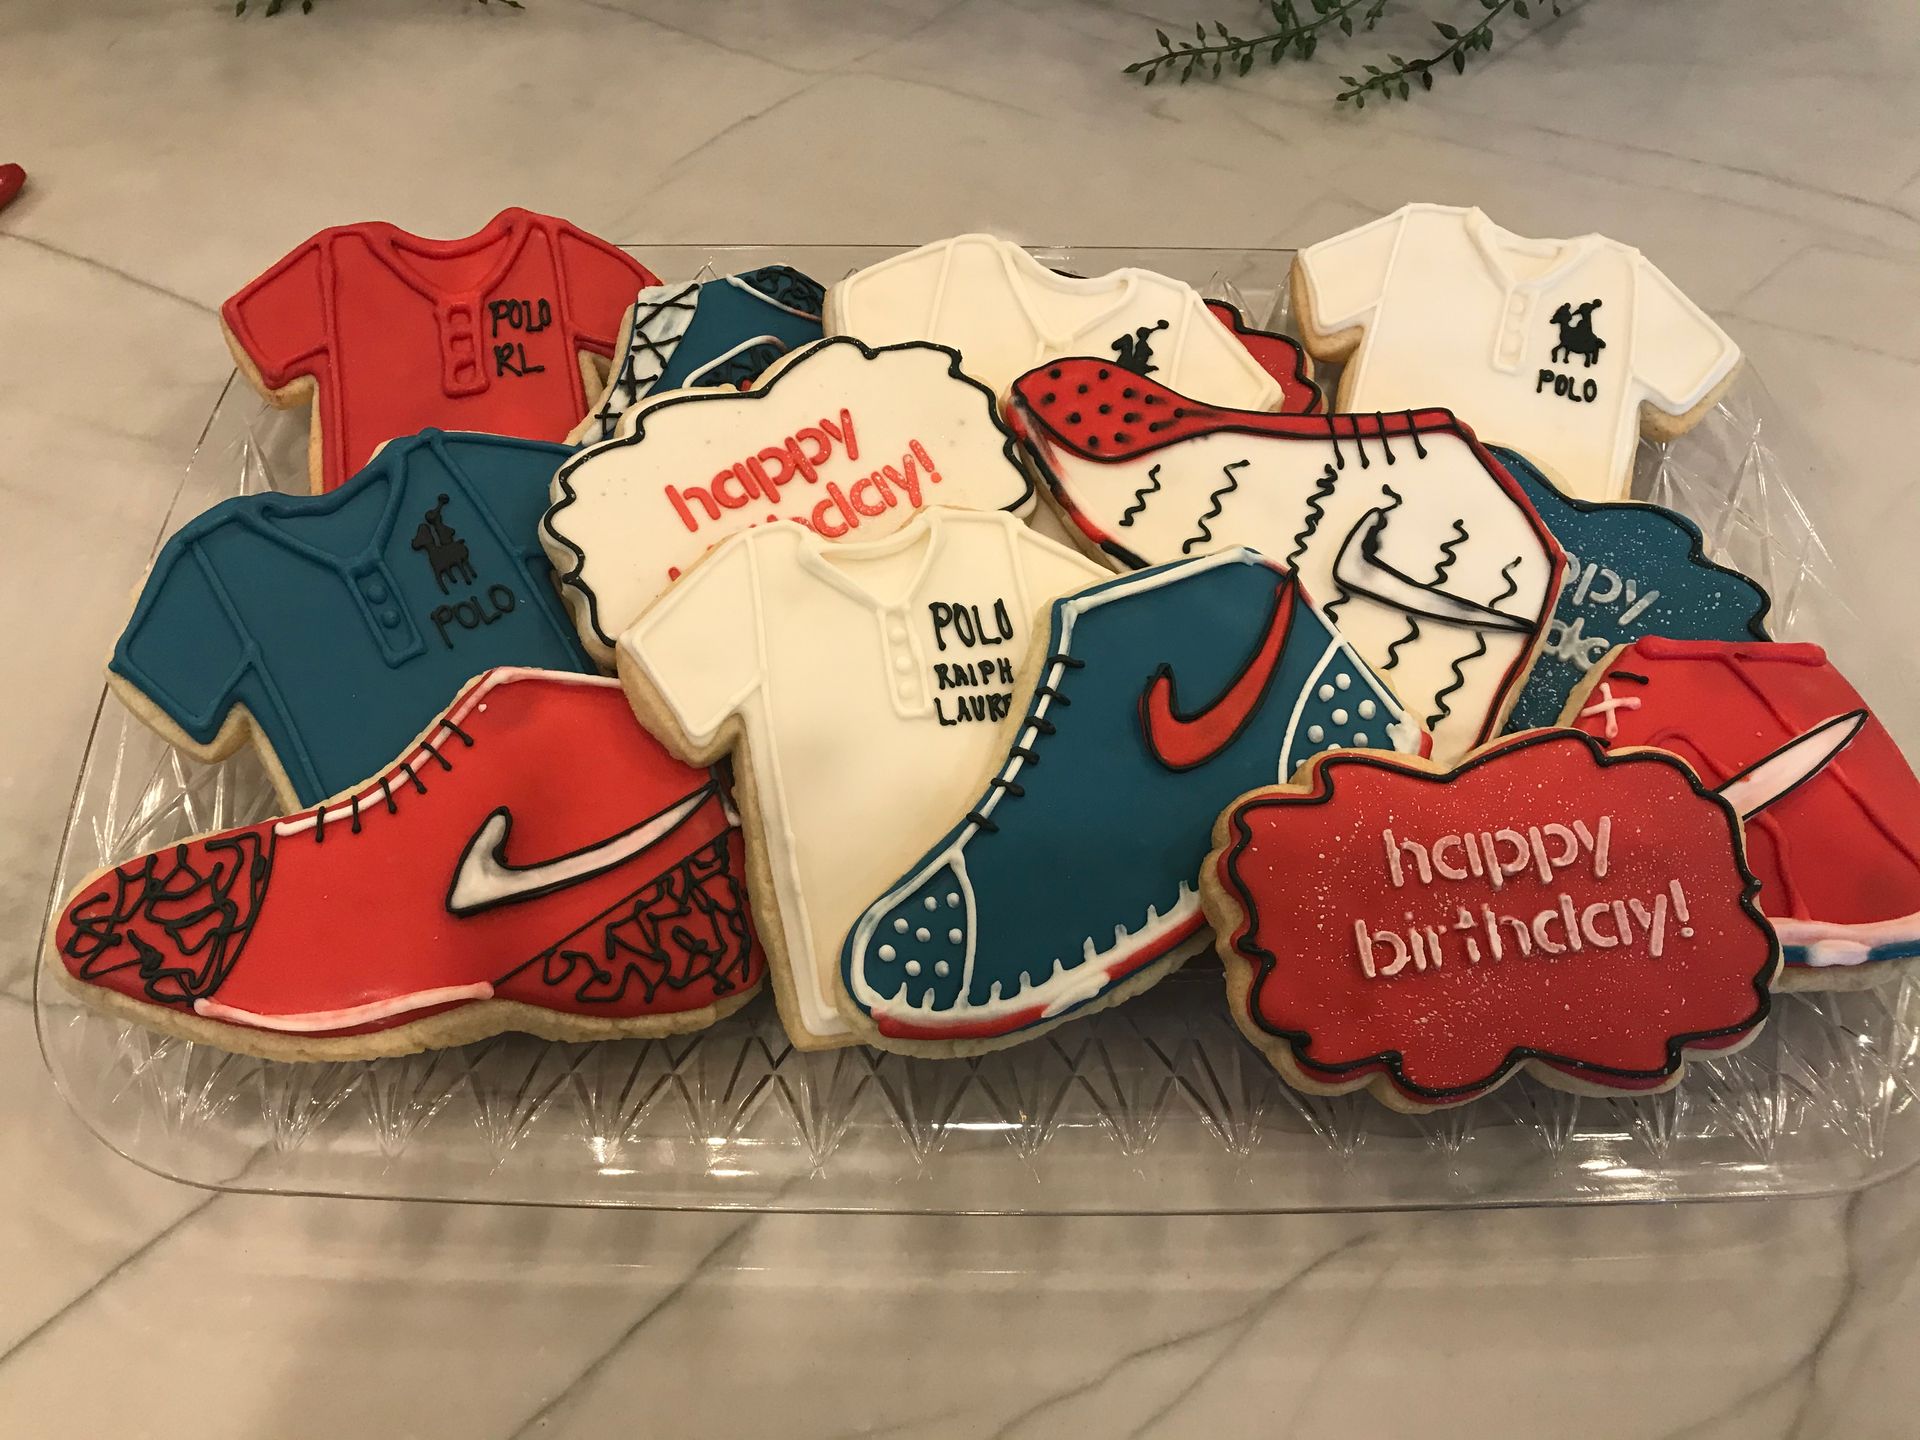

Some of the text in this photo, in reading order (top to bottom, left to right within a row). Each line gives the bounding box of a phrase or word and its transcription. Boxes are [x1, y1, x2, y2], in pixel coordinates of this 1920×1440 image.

[488, 298, 552, 338] POLO
[494, 342, 545, 377] RL
[1536, 368, 1598, 403] POLO
[664, 408, 859, 533] happy
[430, 584, 516, 650] POLO
[928, 597, 1014, 651] POLO
[1383, 815, 1611, 890] happy
[1353, 879, 1695, 980] birthday!
